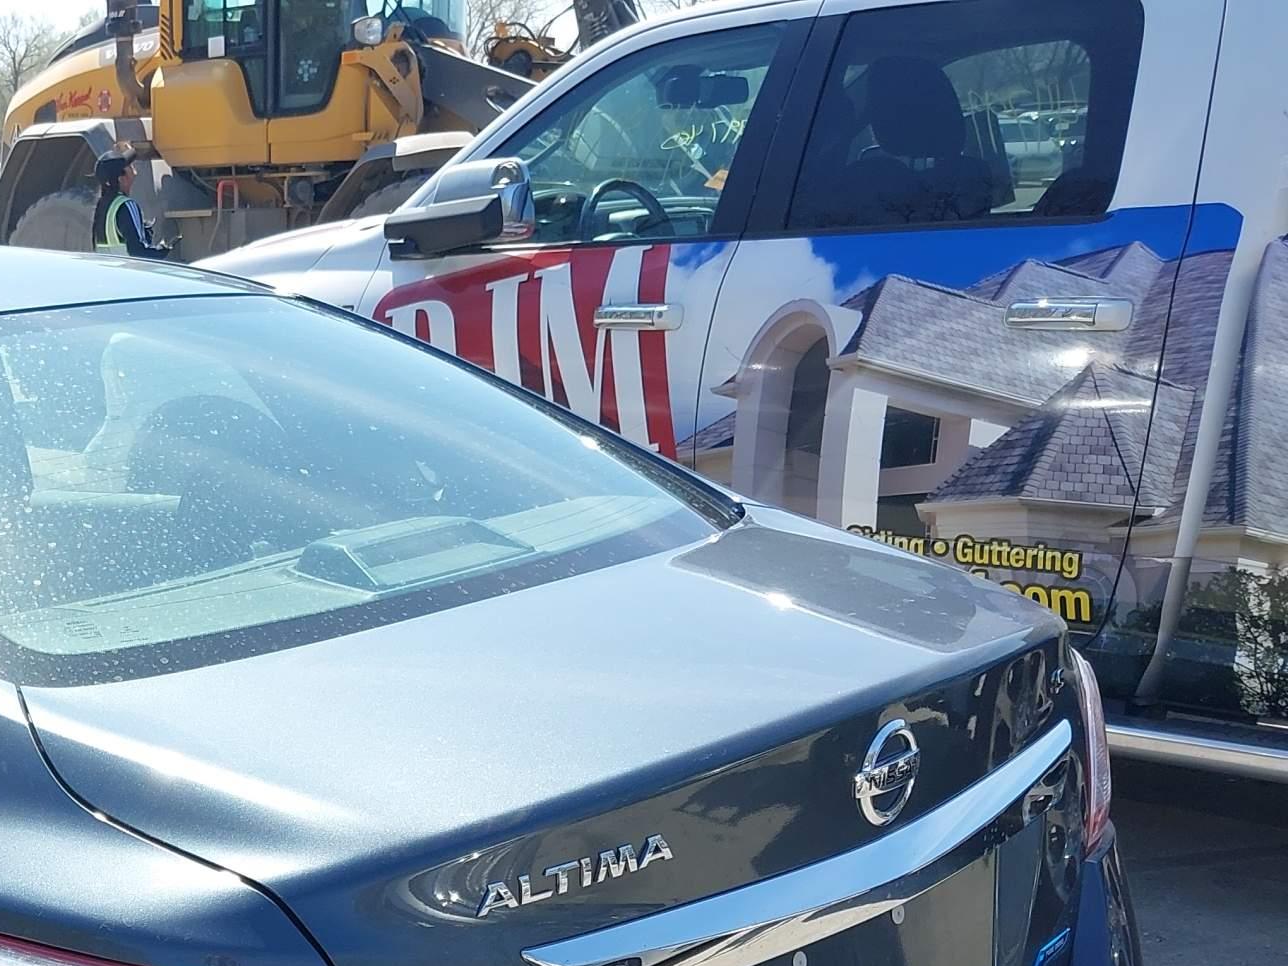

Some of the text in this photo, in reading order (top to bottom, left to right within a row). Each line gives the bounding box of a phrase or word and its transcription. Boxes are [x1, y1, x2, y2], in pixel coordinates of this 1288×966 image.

[848, 527, 1081, 579] ding Guttering
[476, 833, 674, 918] ALTIMA
